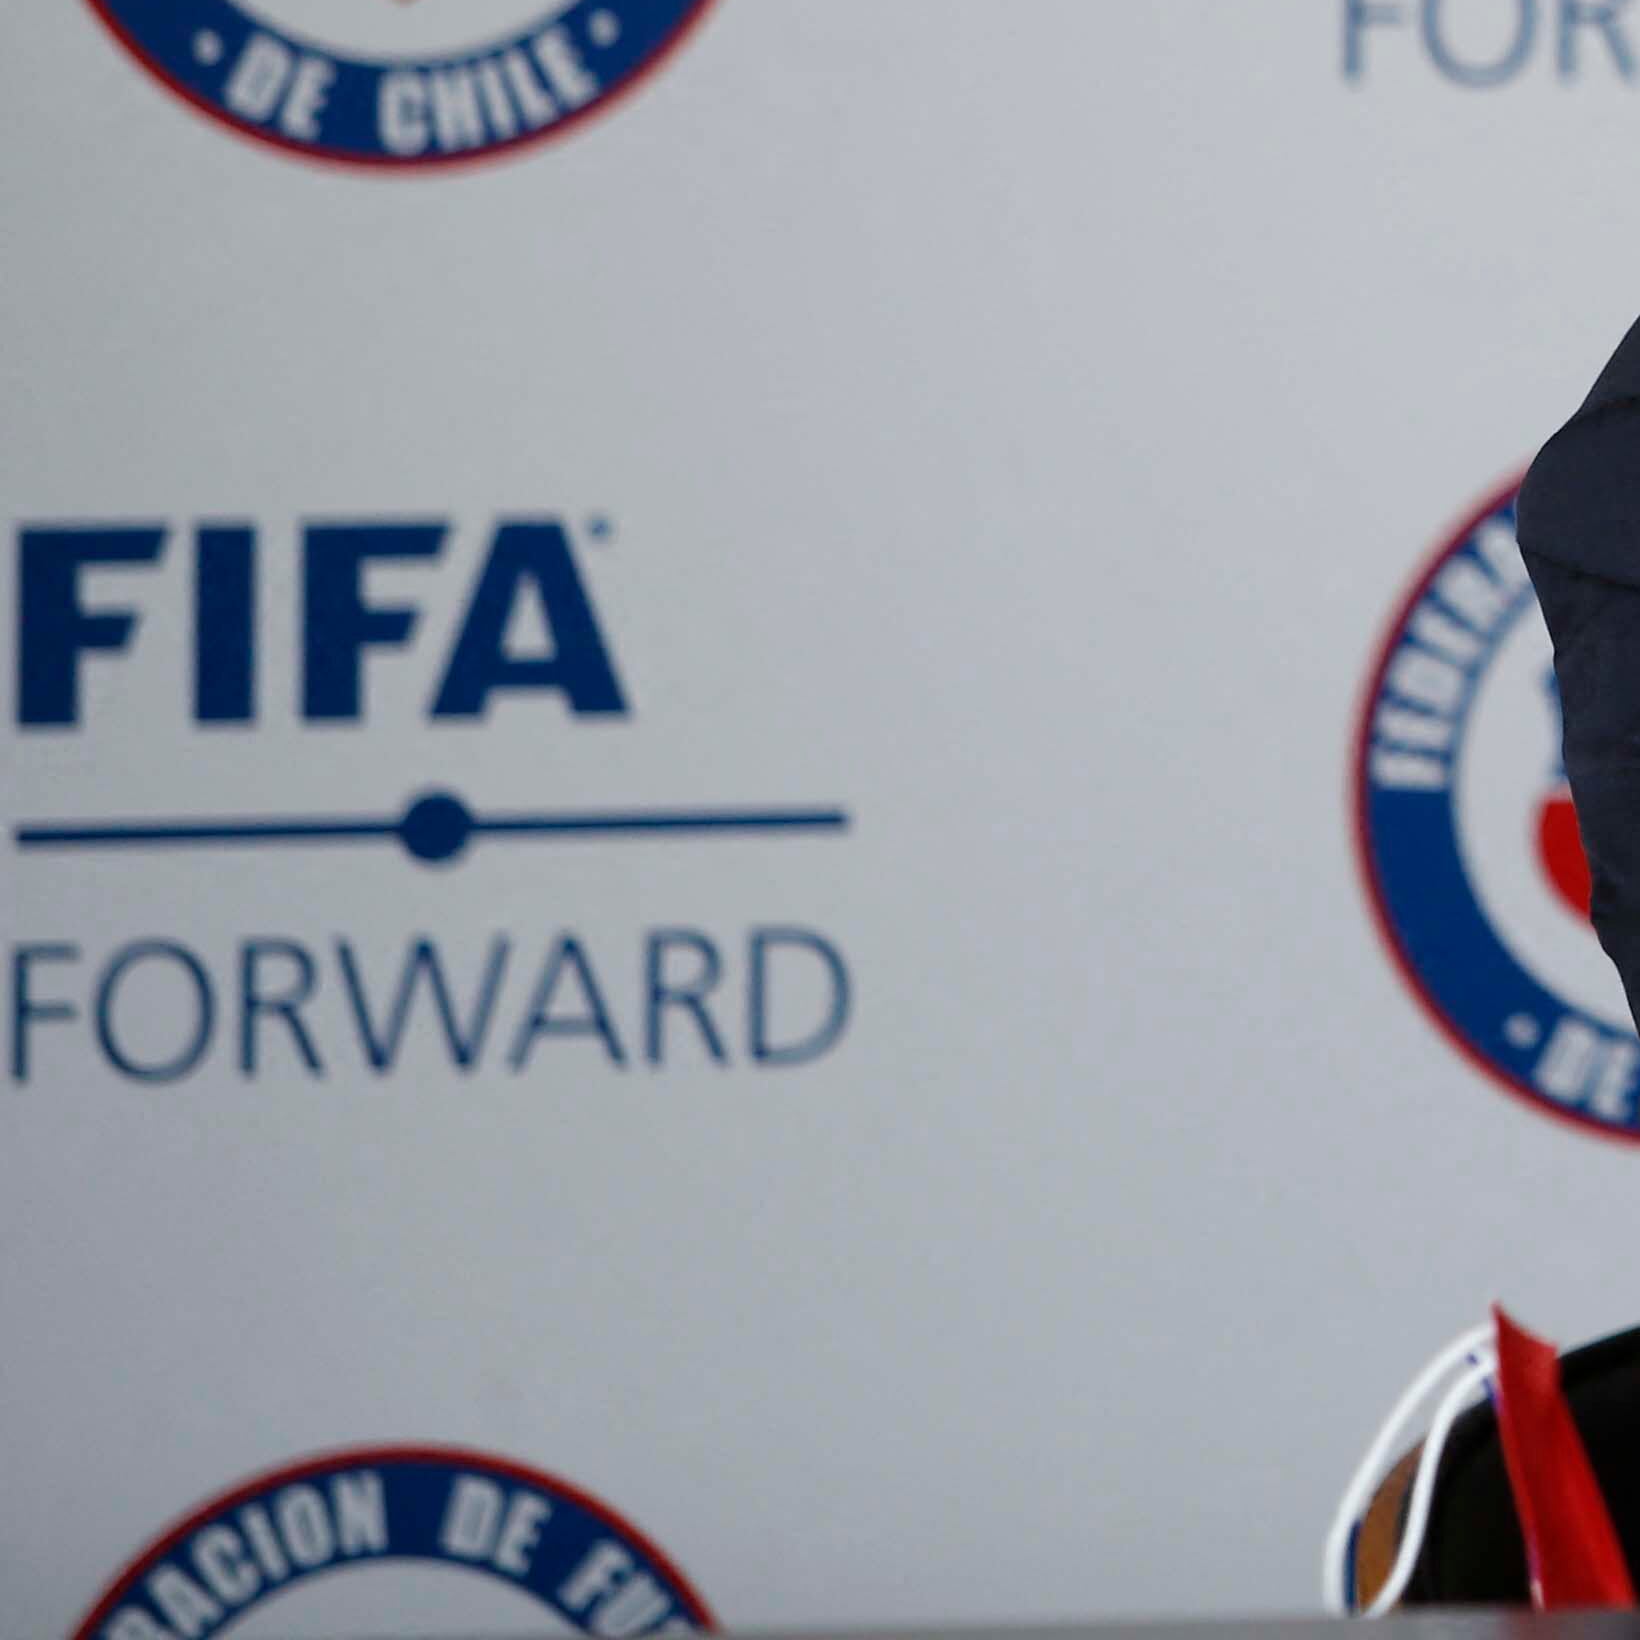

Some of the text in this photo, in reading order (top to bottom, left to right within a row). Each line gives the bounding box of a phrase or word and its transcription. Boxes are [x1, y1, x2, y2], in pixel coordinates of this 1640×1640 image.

[224, 18, 602, 157] DE CHILE
[13, 516, 634, 730] FIFA
[7, 925, 855, 1086] FORWARD
[437, 1471, 554, 1577] DE
